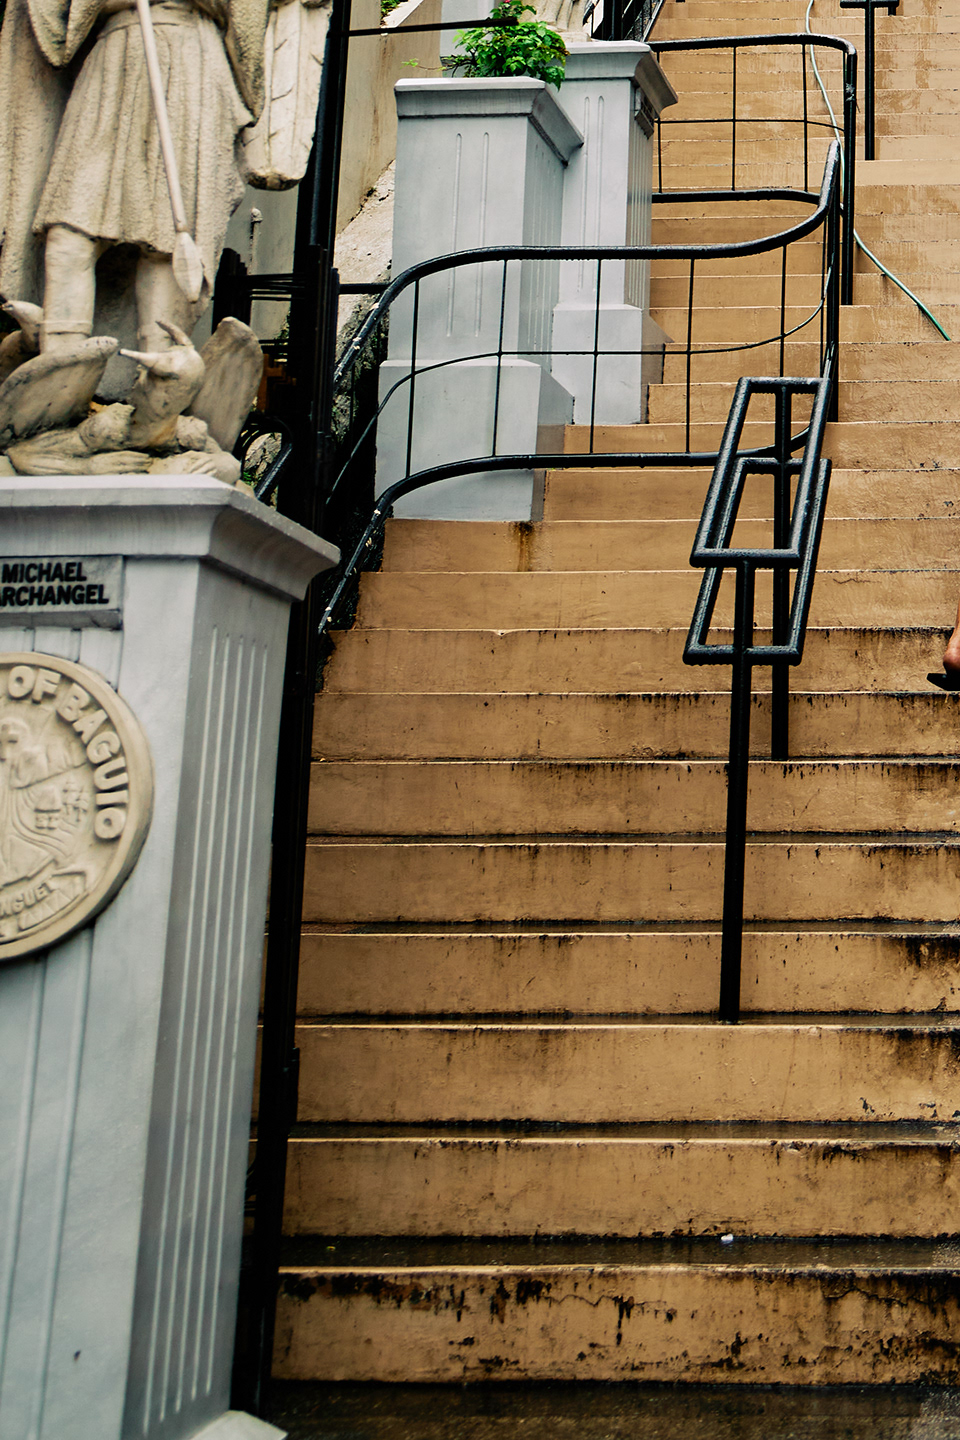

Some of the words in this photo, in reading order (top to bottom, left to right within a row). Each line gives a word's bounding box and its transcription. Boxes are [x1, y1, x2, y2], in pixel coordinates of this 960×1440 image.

[1, 562, 88, 584] MICHAEL
[7, 664, 62, 706] OF
[55, 682, 130, 842] BAGUIO
